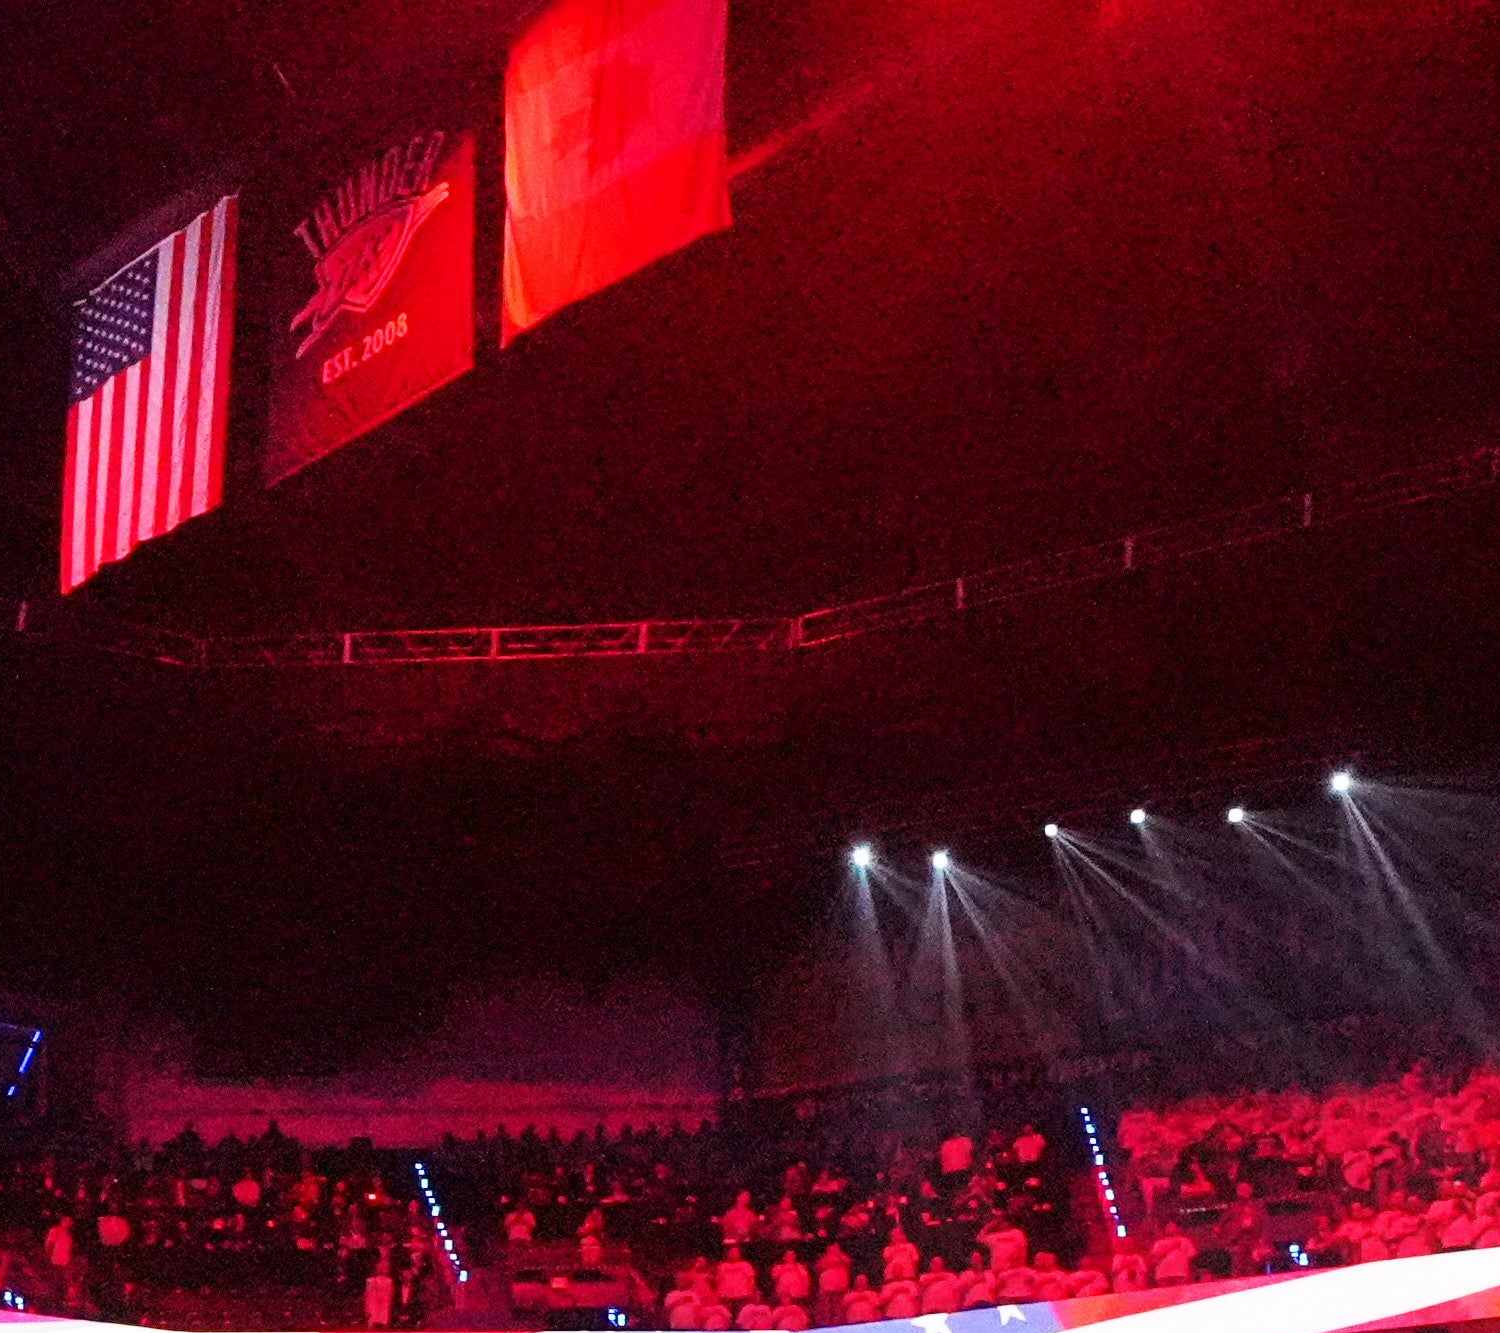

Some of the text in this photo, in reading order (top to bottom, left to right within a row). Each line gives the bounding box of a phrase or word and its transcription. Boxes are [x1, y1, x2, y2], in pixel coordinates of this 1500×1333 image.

[294, 130, 445, 259] THUNDER
[321, 311, 409, 384] EST. 2008
